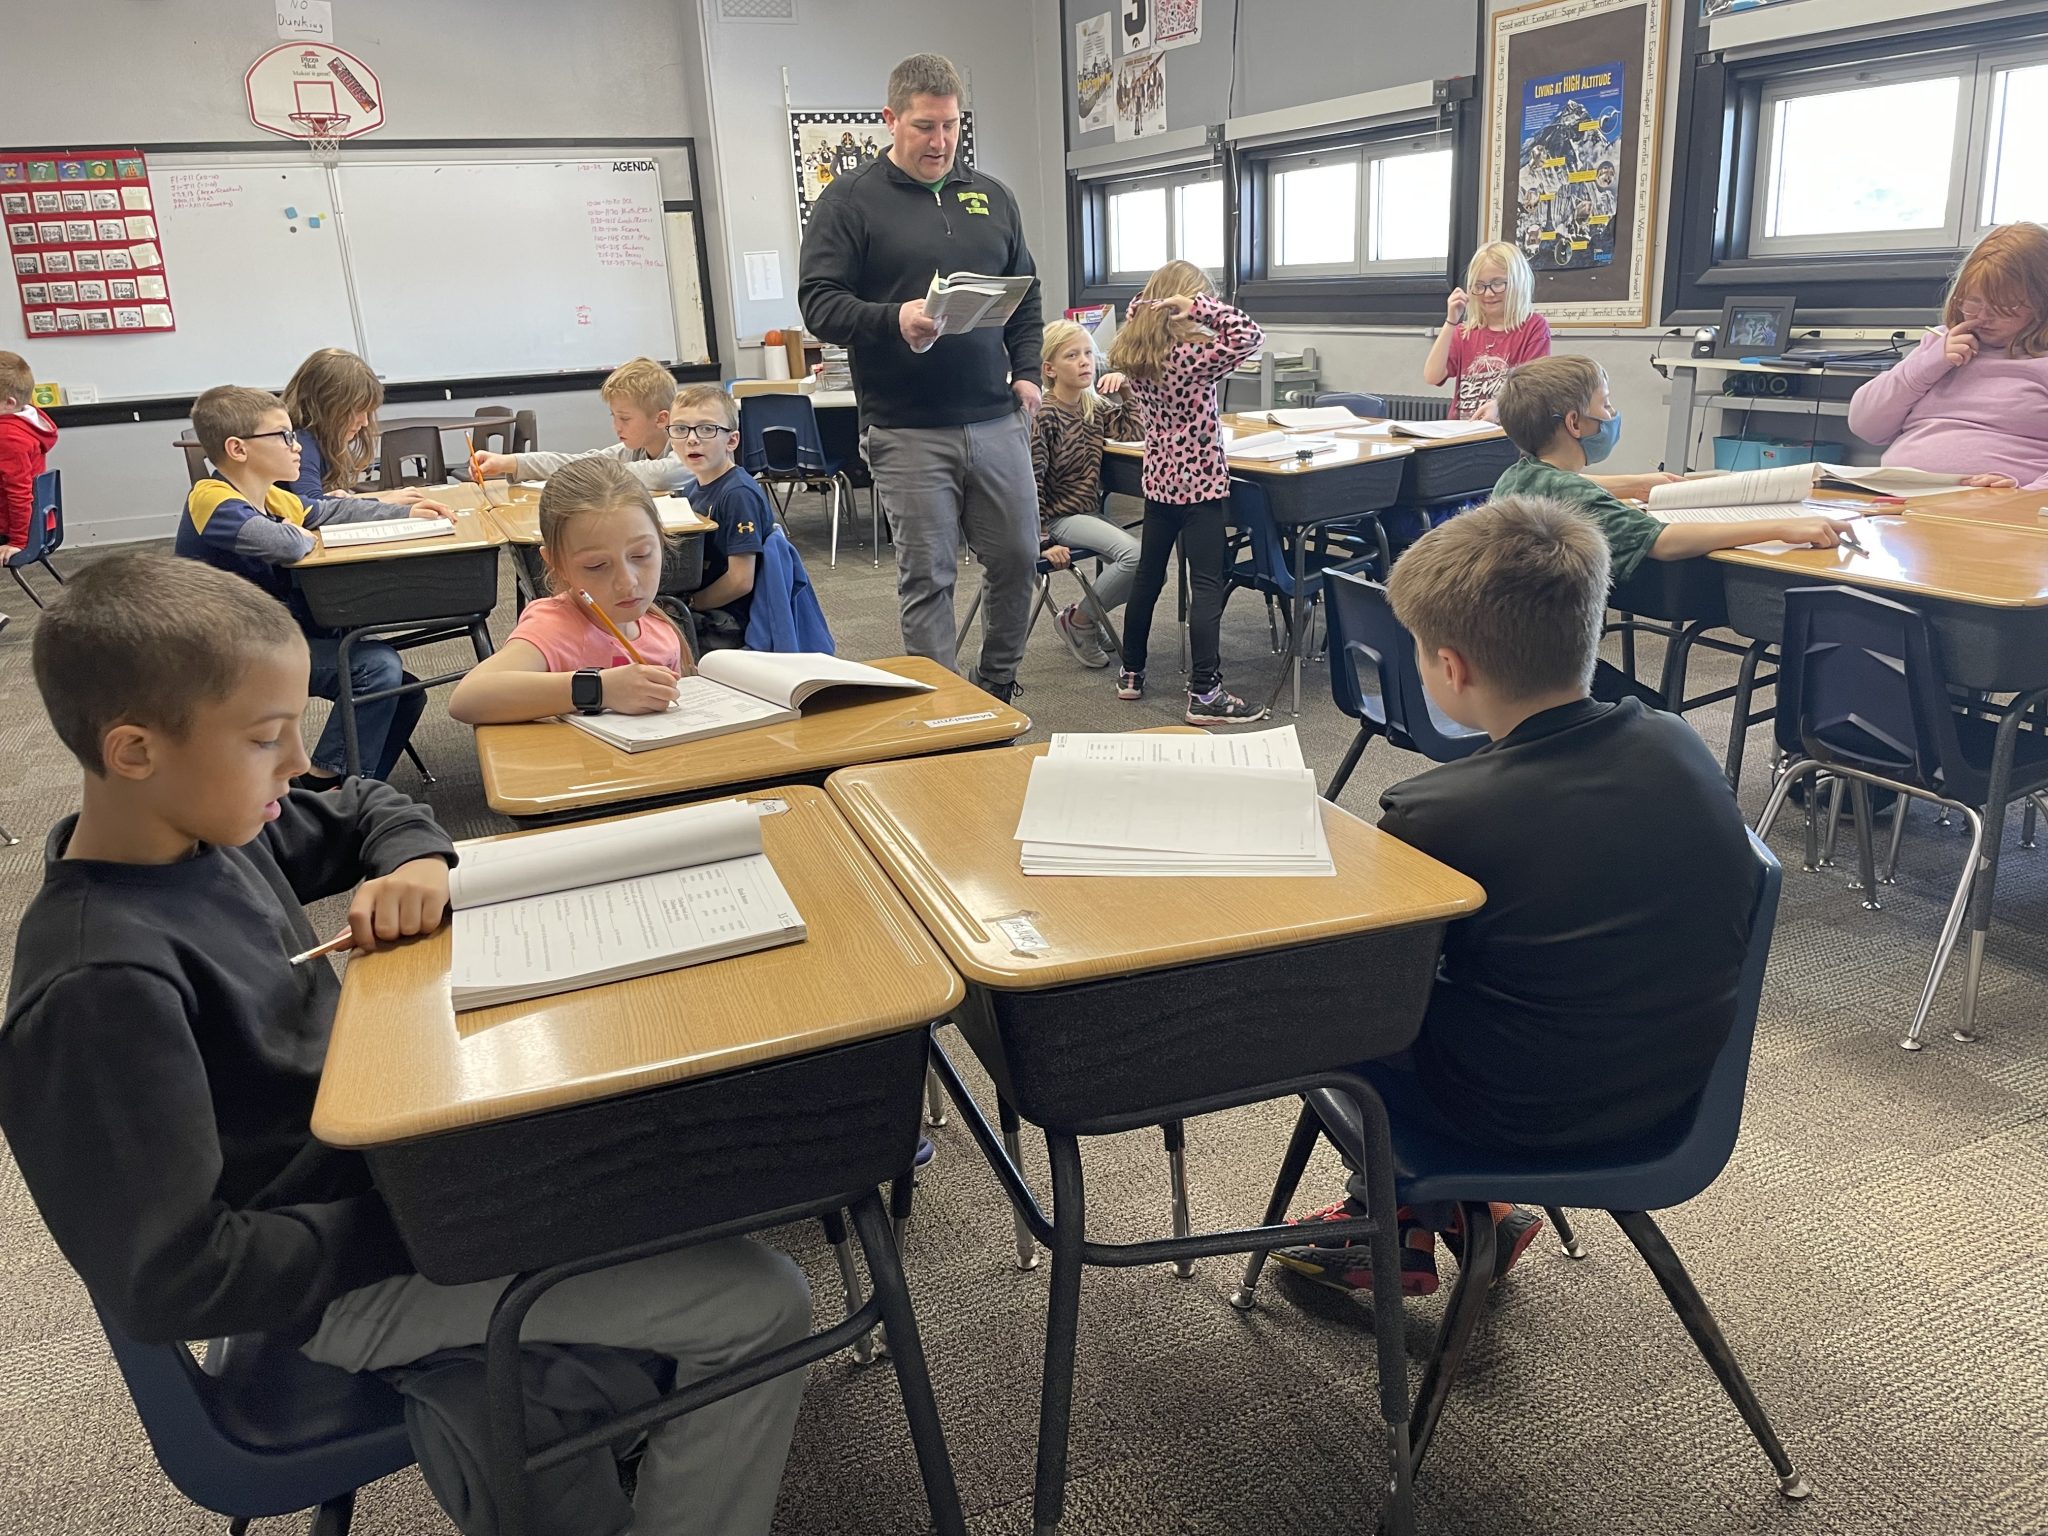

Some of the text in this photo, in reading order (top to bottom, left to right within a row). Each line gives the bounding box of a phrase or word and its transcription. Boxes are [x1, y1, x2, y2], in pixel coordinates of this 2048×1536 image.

[278, 13, 323, 33] Dunking
[1499, 20, 1513, 31] Good
[1514, 17, 1529, 28] work!
[1532, 9, 1557, 23] Excellent!
[1562, 7, 1577, 18] Super
[1576, 2, 1587, 16] job!
[1535, 73, 1612, 98] LIVING AT HIGH ALTITUDE
[1644, 89, 1653, 112] Super
[612, 161, 656, 172] AGENDA
[841, 156, 857, 170] 19
[1640, 173, 1647, 187] Go
[1634, 255, 1642, 276] Good
[1562, 308, 1577, 319] Super
[1617, 307, 1626, 316] Go
